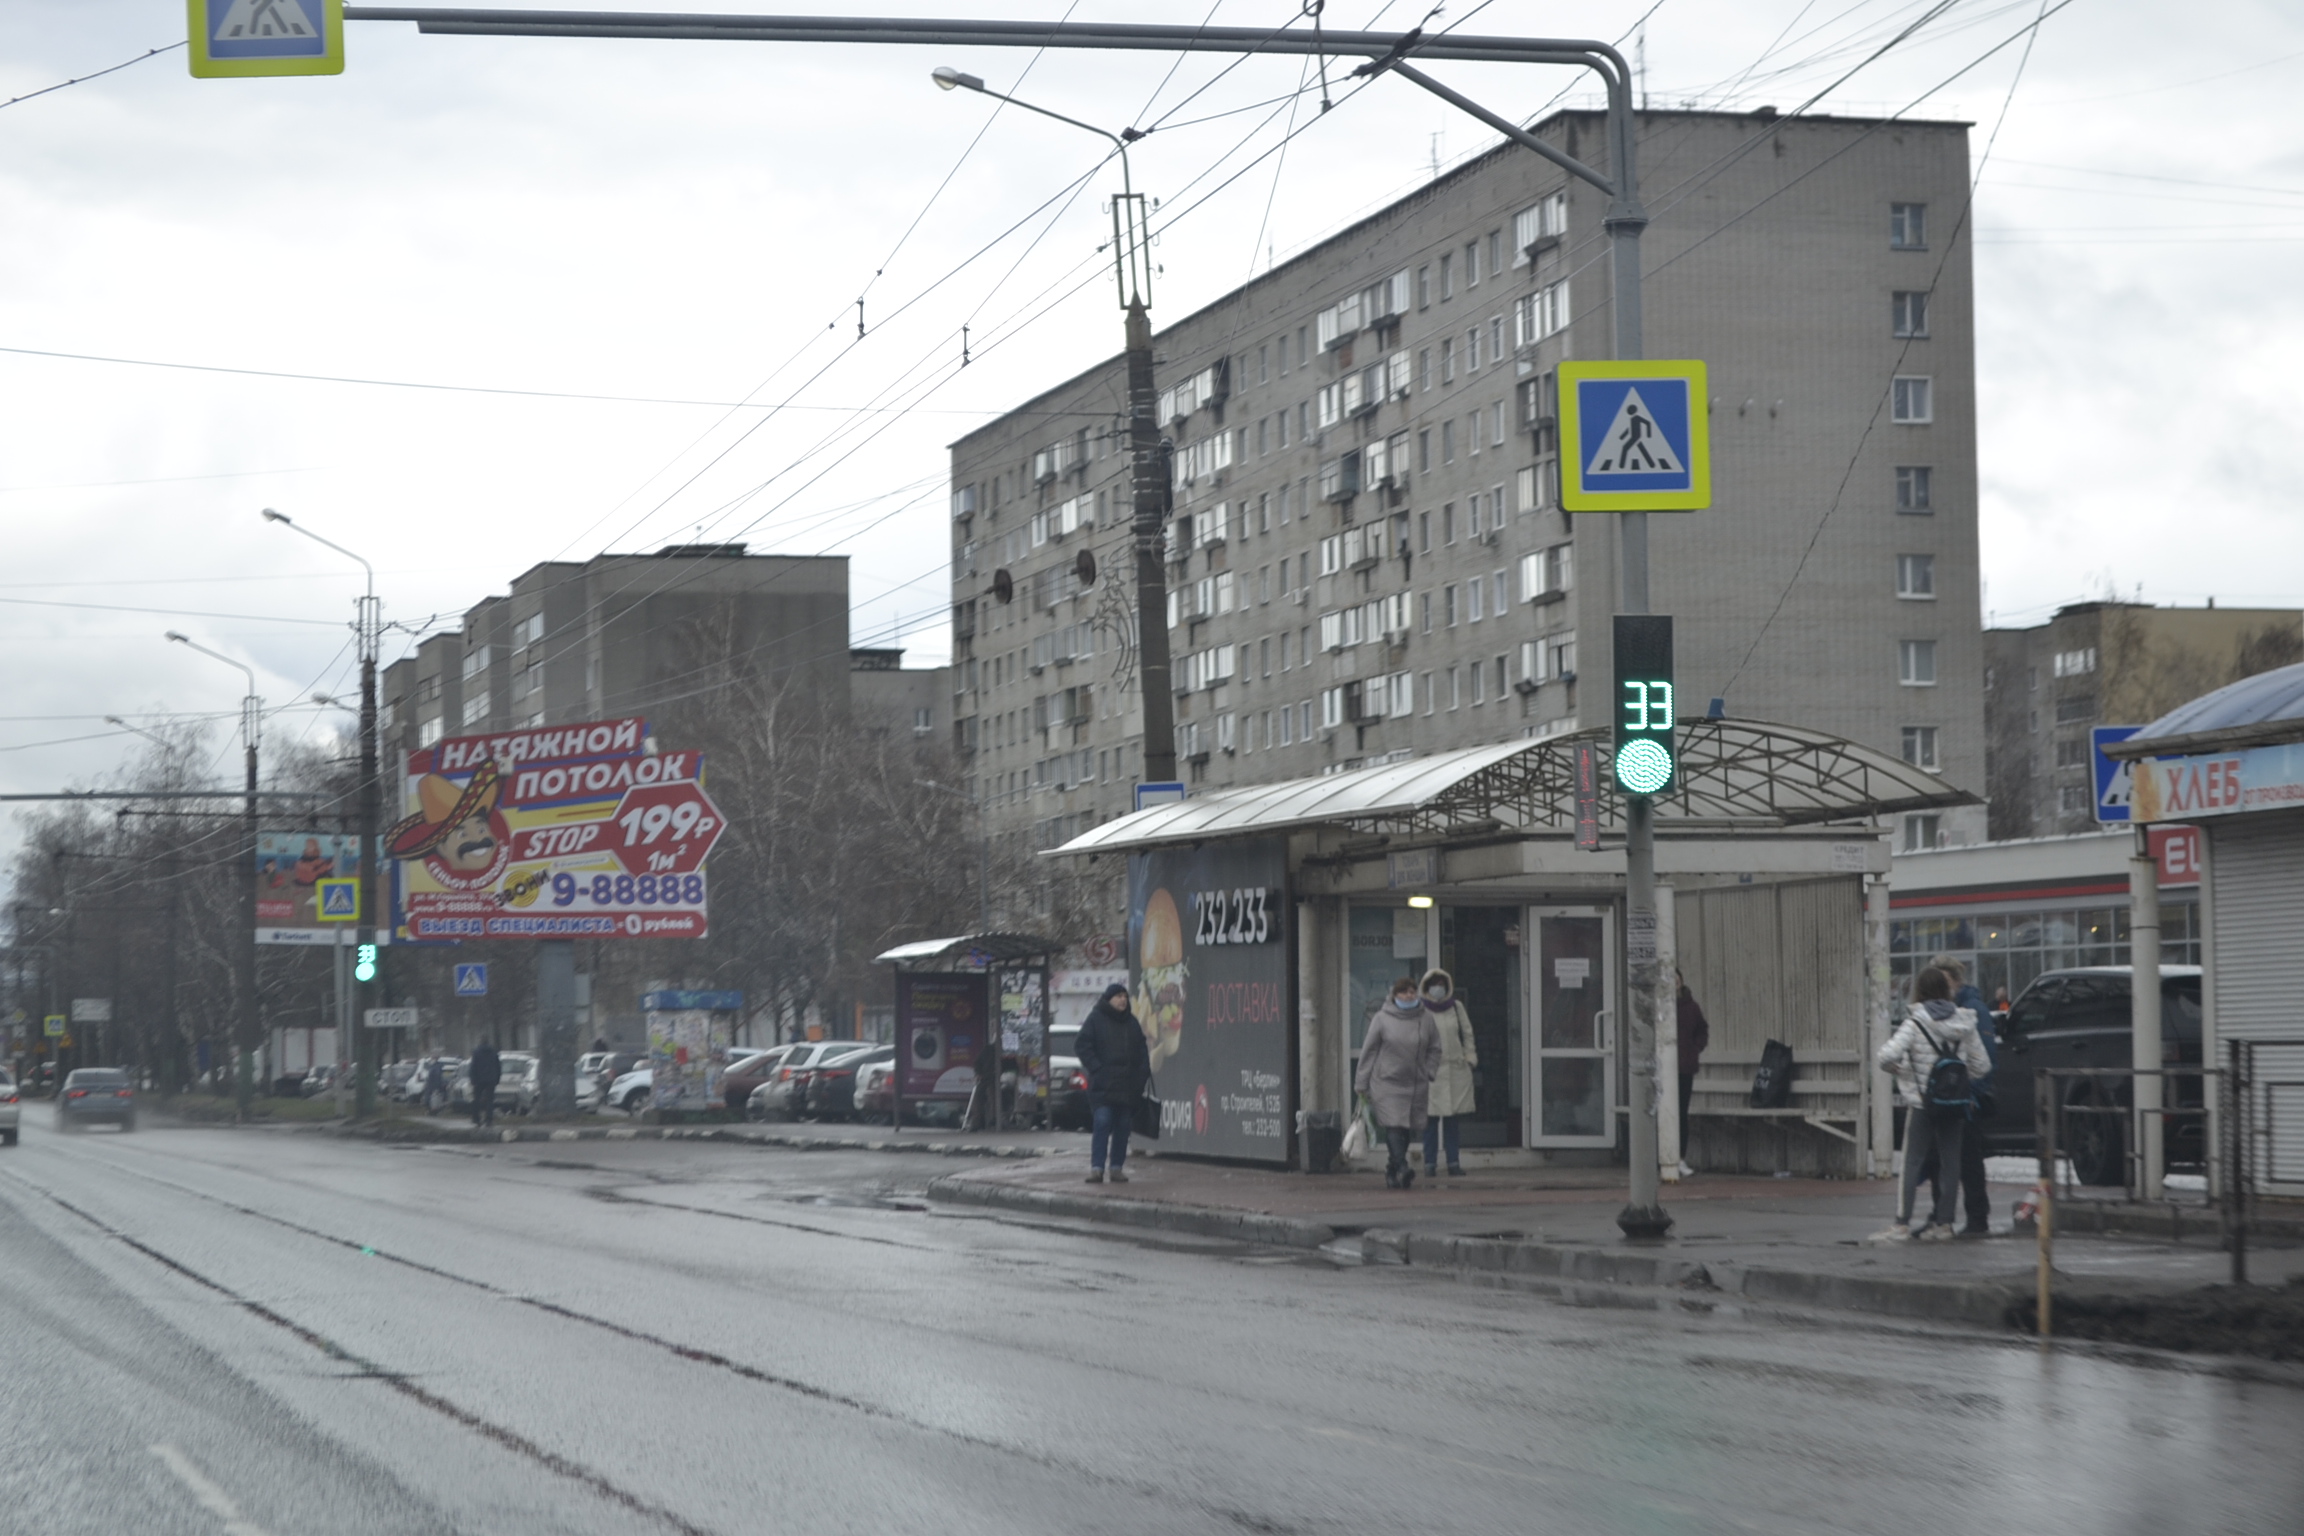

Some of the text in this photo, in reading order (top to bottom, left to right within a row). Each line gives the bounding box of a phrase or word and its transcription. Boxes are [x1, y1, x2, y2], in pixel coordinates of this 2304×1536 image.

[1624, 681, 1673, 730] 33
[441, 718, 638, 770] НАТЯЖНОЙ
[514, 753, 686, 800] ПОТОЛОК
[2166, 760, 2240, 812] ХЛЕБ
[524, 823, 600, 859] STOP
[551, 871, 704, 907] 9-88888
[418, 917, 483, 936] ВЫЕЗД
[487, 916, 616, 936] СПЕЦИАЛИСТА
[644, 917, 695, 932] рублей
[1207, 983, 1279, 1030] ДОСТАВКА
